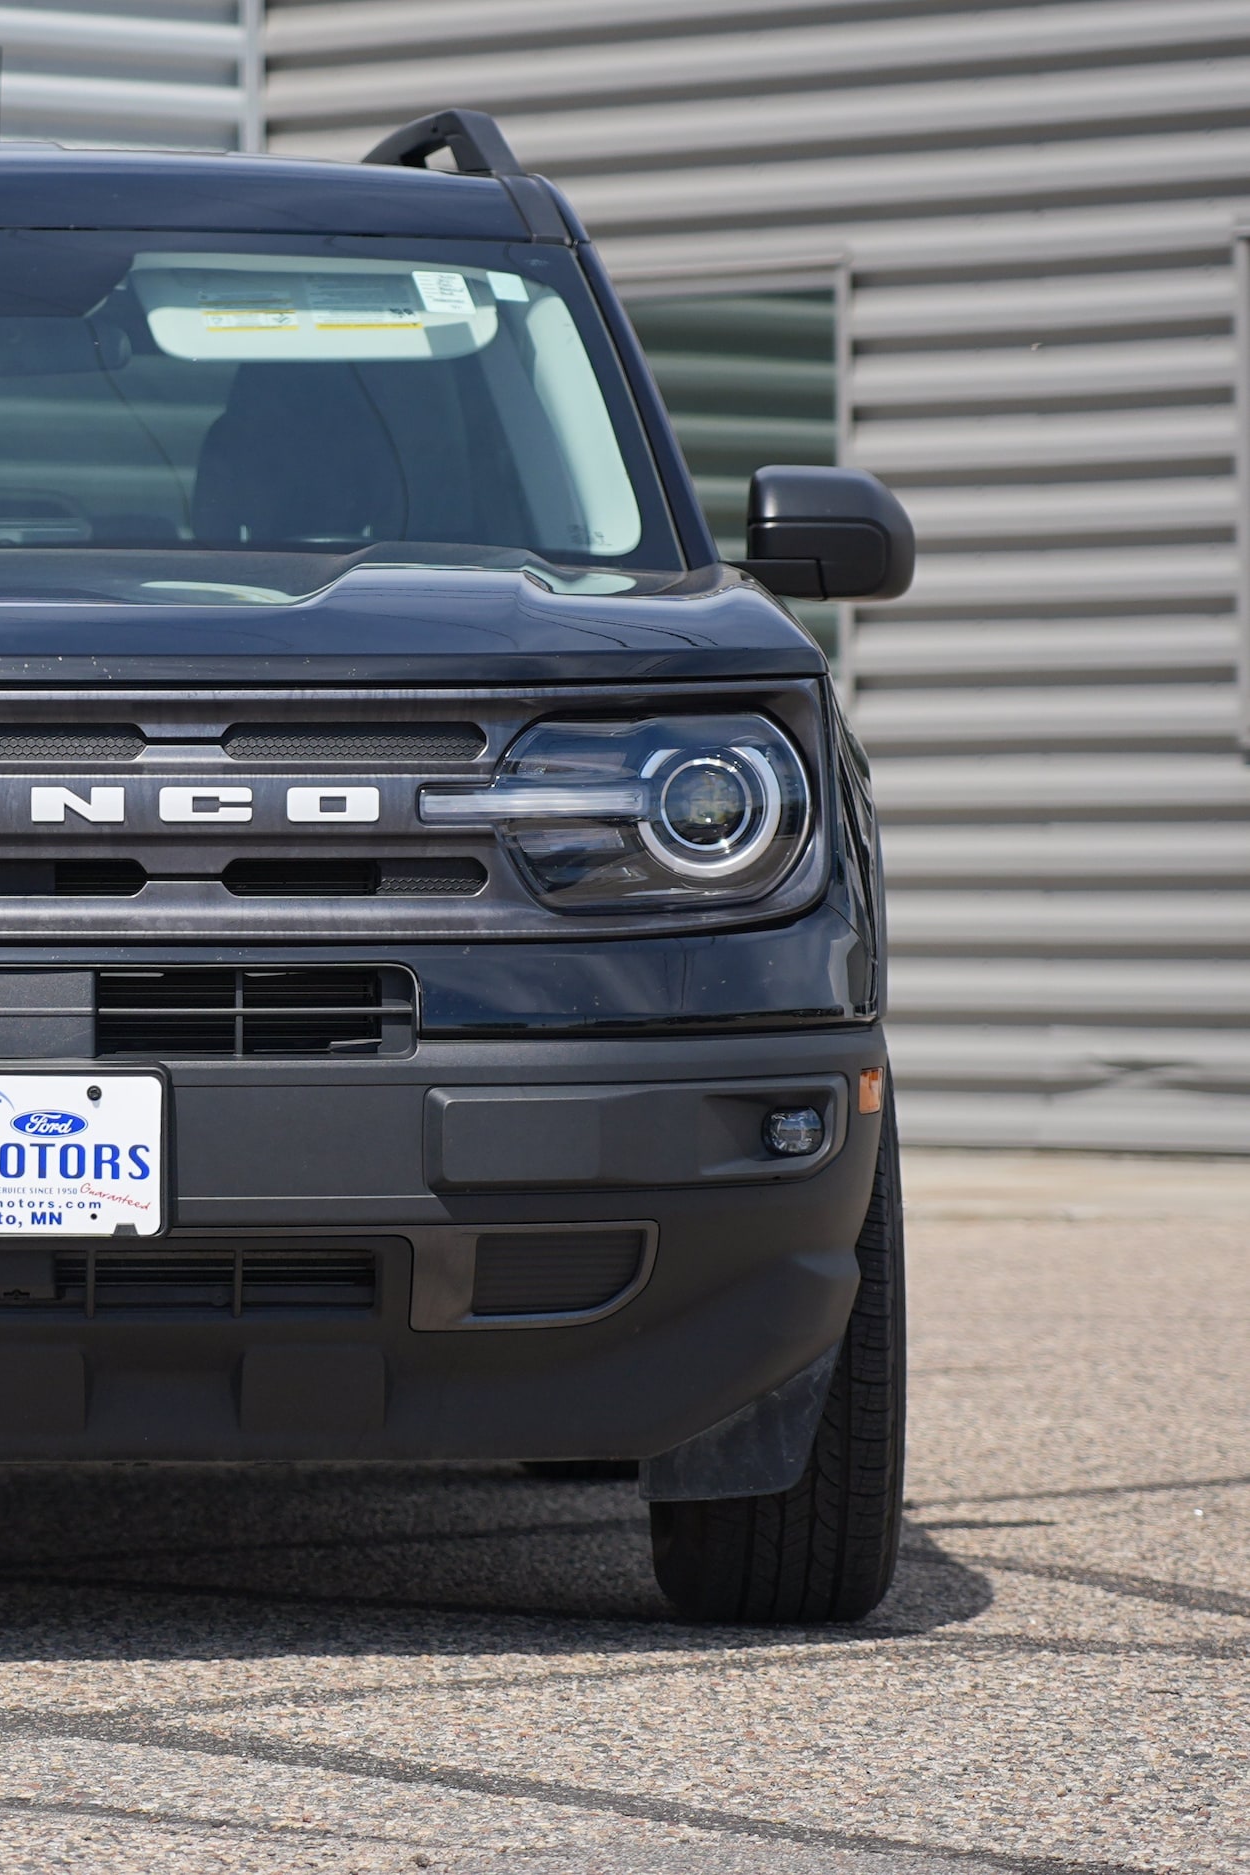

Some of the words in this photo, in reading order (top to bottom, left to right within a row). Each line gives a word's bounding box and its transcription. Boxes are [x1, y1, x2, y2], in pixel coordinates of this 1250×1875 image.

[25, 1113, 73, 1135] Ford
[30, 1187, 55, 1195] SINCE
[57, 1187, 78, 1195] 1950
[80, 1182, 150, 1211] Guaranteed
[31, 1212, 63, 1225] MN
